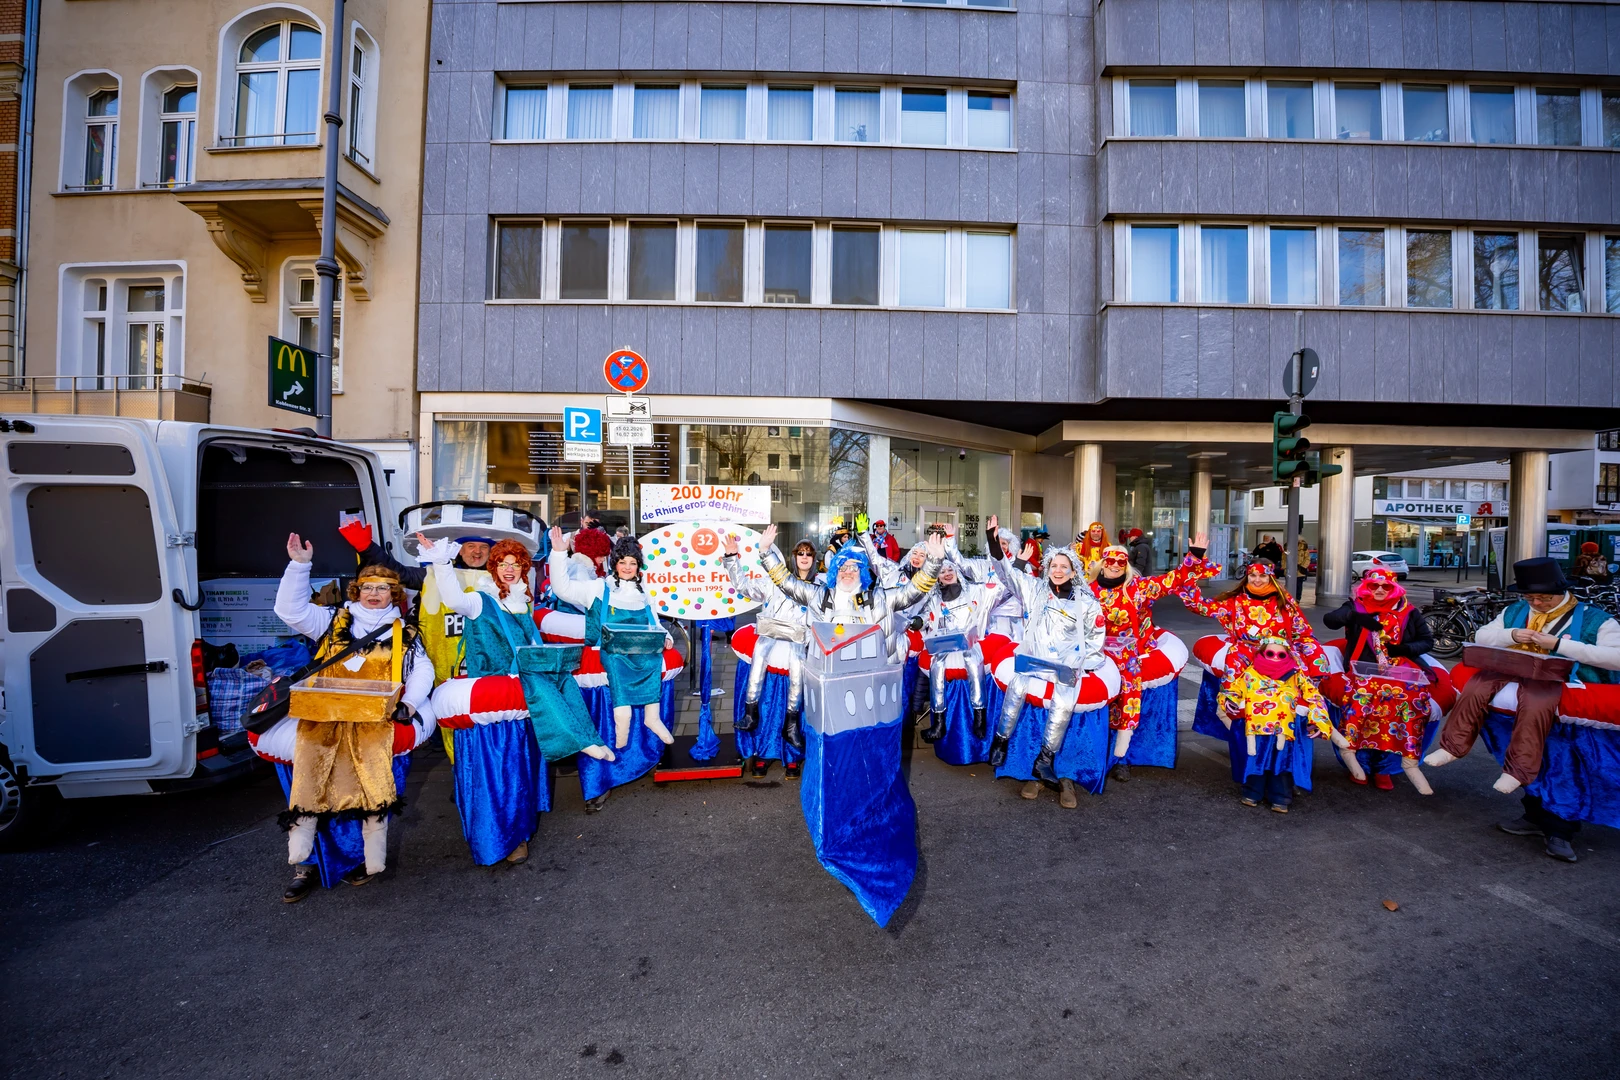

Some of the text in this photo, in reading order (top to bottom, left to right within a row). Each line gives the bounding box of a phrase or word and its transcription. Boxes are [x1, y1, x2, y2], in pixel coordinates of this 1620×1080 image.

[275, 399, 299, 409] Koblenzer
[570, 411, 591, 438] P
[670, 485, 744, 502] 200 Johr
[641, 511, 655, 521] de
[655, 504, 685, 517] Rhing
[684, 500, 707, 511] erop
[708, 500, 722, 509] de
[721, 502, 749, 518] Rhing
[1384, 502, 1464, 514] APOTHEKE
[965, 514, 975, 522] THIS
[965, 522, 979, 530] YOUR
[696, 533, 714, 546] 32
[1549, 536, 1569, 546] DIXI
[646, 571, 763, 584] Kölsche Frde
